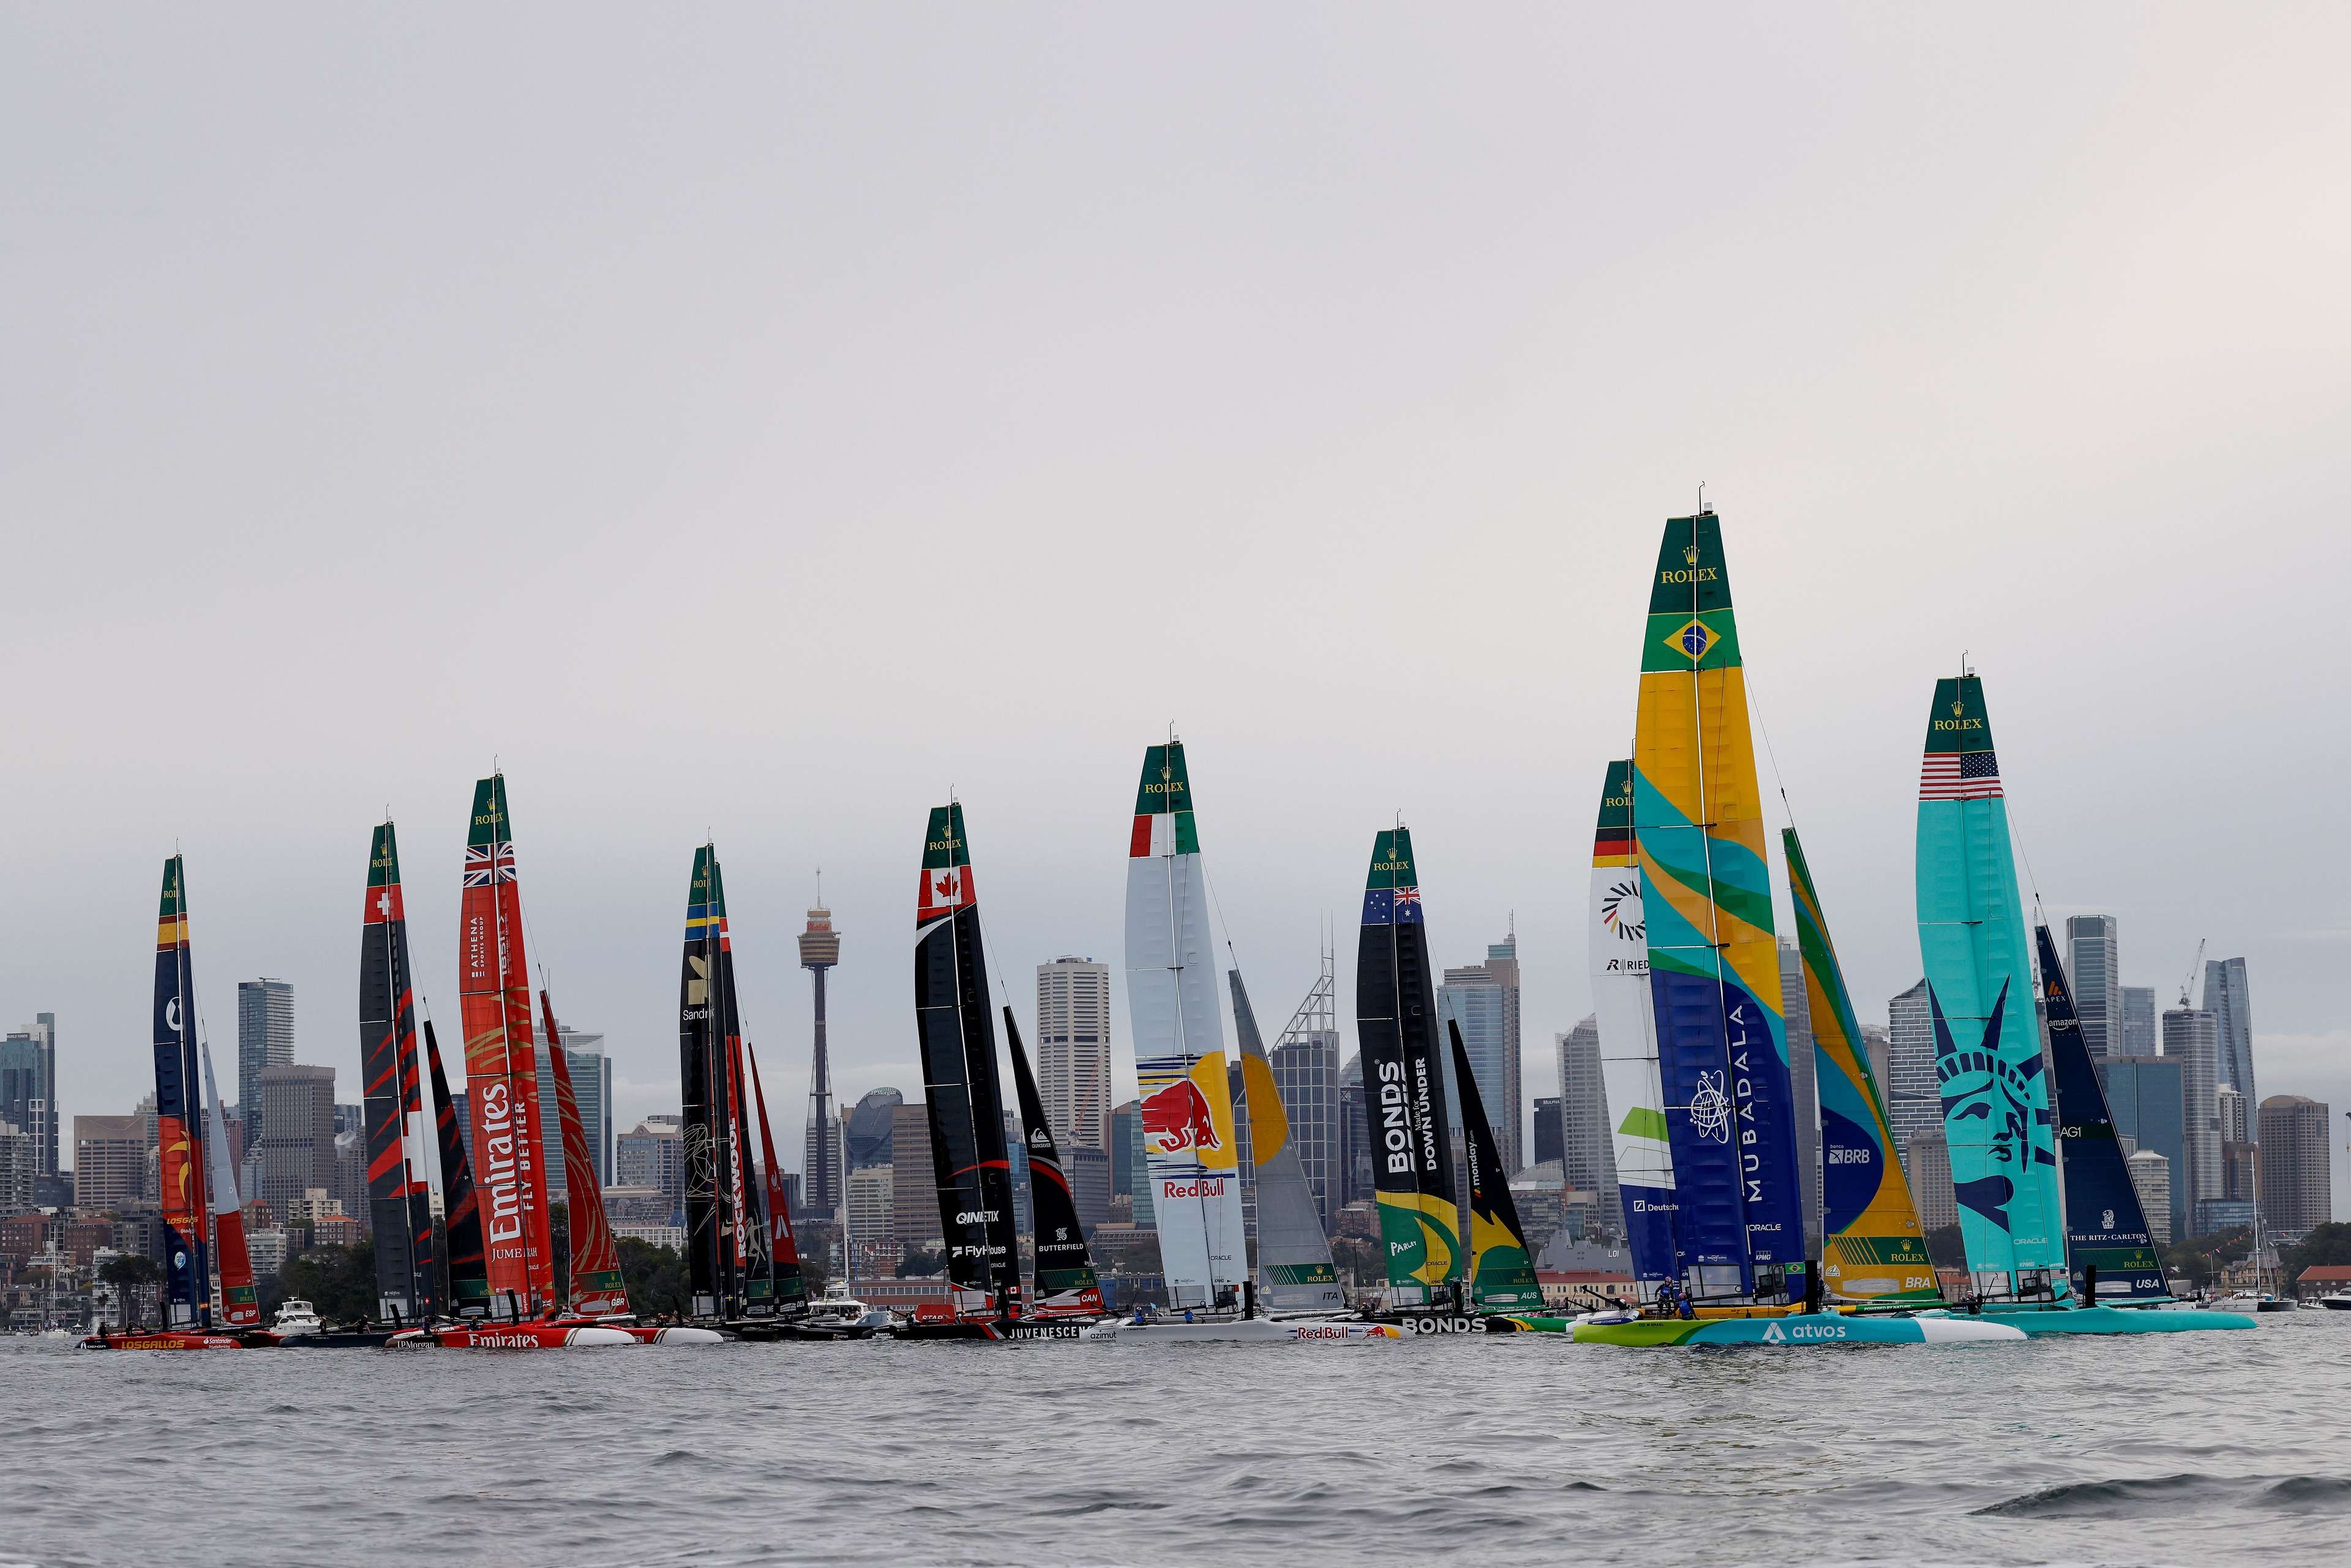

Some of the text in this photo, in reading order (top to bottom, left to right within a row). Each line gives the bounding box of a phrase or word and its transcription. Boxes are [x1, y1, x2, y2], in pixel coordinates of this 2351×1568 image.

[1660, 567, 1717, 583] ROLEX
[1935, 718, 1982, 730] ROLEX
[1145, 782, 1184, 793] ROLEX
[1606, 797, 1635, 806] ROL
[475, 812, 503, 825] ROLEX
[929, 839, 962, 850] ROLEX
[1373, 861, 1409, 871] ROLEX
[693, 879, 711, 888] ROL
[163, 890, 180, 898] ROL
[1729, 1005, 1763, 1202] MUBADALA
[1415, 1057, 1437, 1170] DOWN UNDER
[2060, 1127, 2081, 1137] AG1
[515, 1101, 533, 1210] FLY BETTER
[1469, 1130, 1480, 1186] monday.com
[1844, 1149, 1870, 1163] BRB
[481, 1084, 520, 1244] Emirates
[730, 1117, 746, 1258] ROCKWOOL
[1164, 1177, 1224, 1198] Red Bull
[966, 1245, 1006, 1258] FlyHouse
[1038, 1243, 1084, 1252] BUTTERFIELD
[1390, 1240, 1417, 1256] PARLEY
[492, 1247, 538, 1262] JUMEIRAH
[1891, 1253, 1925, 1262] ROLEX
[1905, 1277, 1930, 1288] BRA
[2136, 1279, 2159, 1288] USA
[611, 1297, 624, 1307] GBR
[1081, 1294, 1098, 1302] CAN
[1322, 1292, 1338, 1300] ITA
[1009, 1326, 1092, 1339] JUVENESCEN
[1090, 1330, 1117, 1339] azimut
[1297, 1326, 1348, 1339] Red Bull
[1792, 1323, 1846, 1338] atvos
[122, 1340, 185, 1350] LOSGALLOS
[468, 1332, 539, 1347] Emirates
